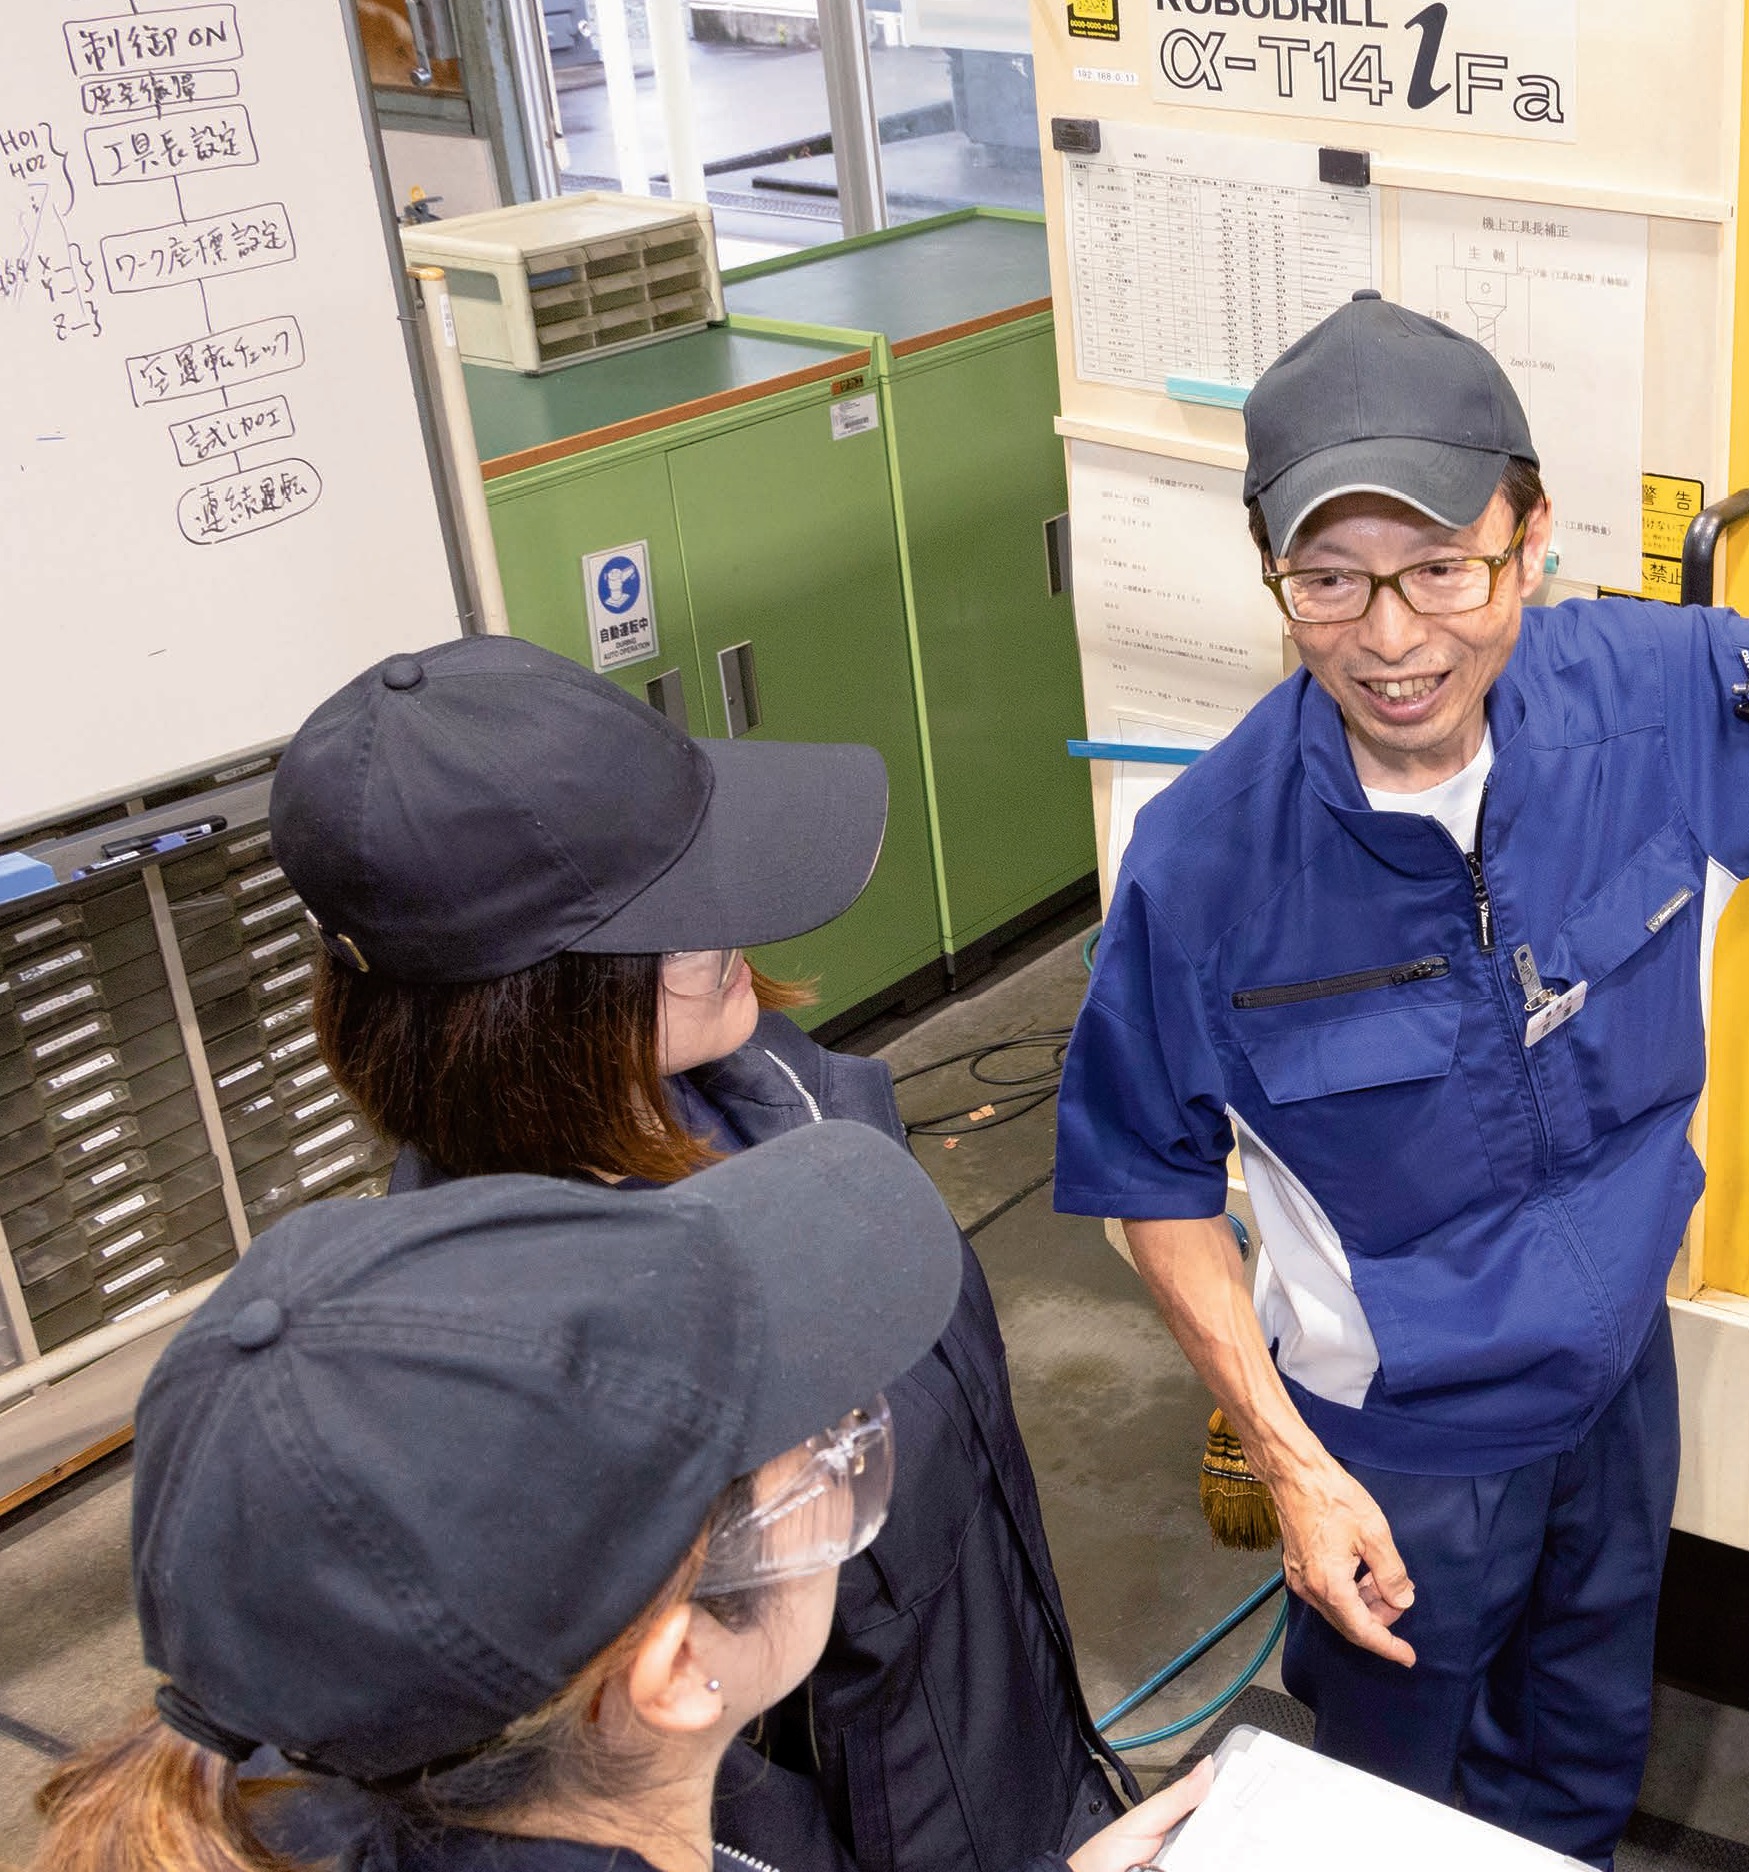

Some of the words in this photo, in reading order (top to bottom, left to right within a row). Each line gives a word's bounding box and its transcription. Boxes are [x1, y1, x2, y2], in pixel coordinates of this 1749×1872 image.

[79, 25, 177, 71] 制御
[189, 20, 226, 46] ON
[104, 121, 241, 176] 工具長設定
[115, 220, 288, 282] ワーク座標設定
[1482, 216, 1570, 238] 機上工具長補正
[139, 331, 290, 397] 空運転チェック
[186, 409, 281, 458] 試し加工
[195, 473, 308, 536] 連続運転
[1643, 561, 1682, 586] 禁止
[600, 617, 648, 643] 自動運転中
